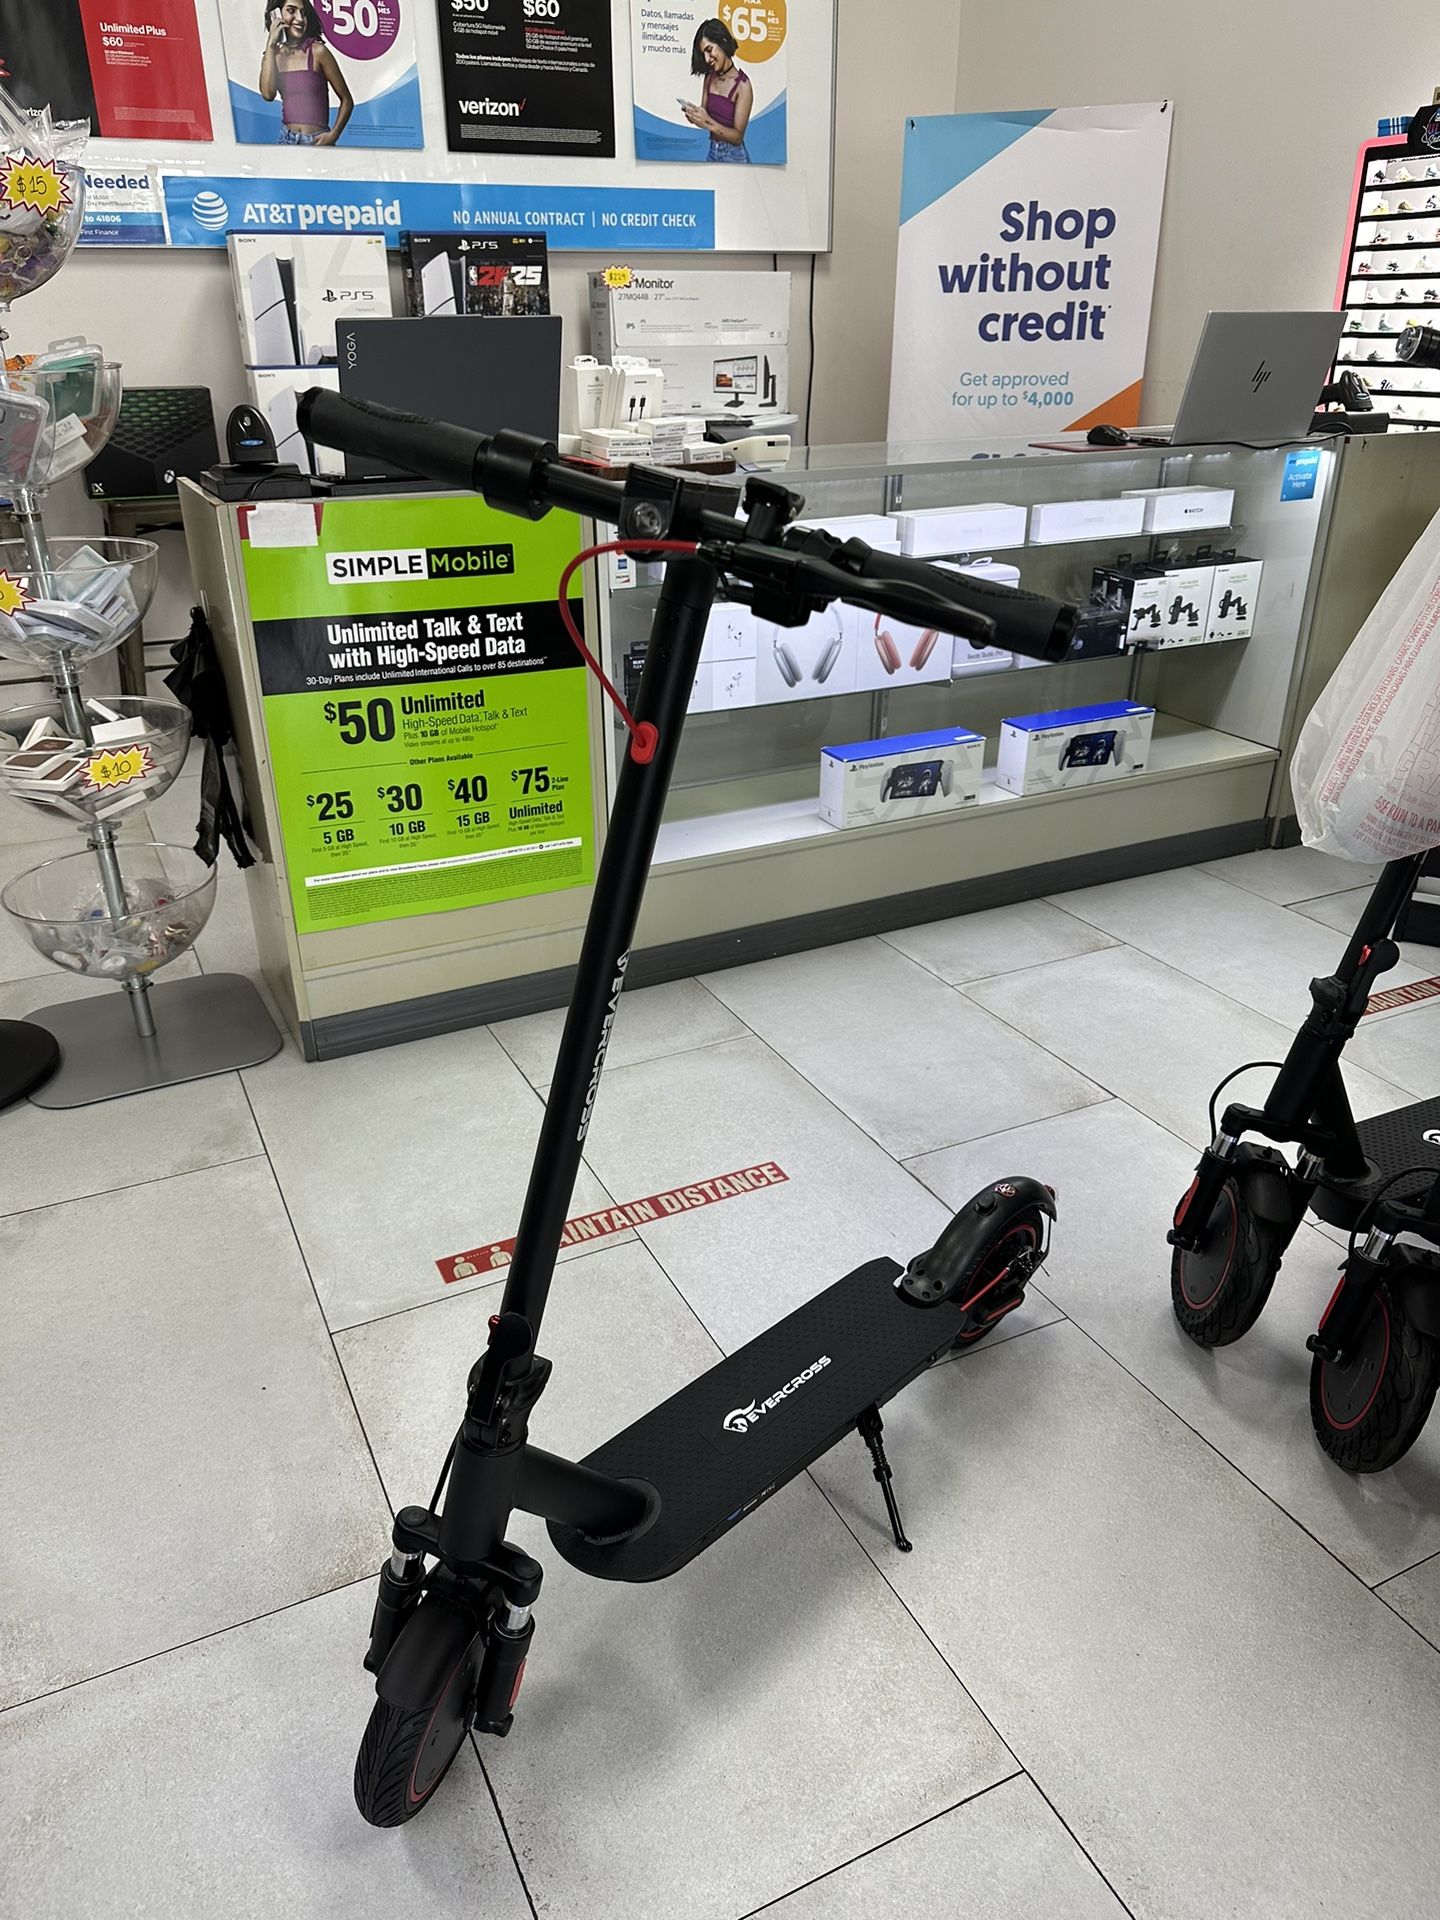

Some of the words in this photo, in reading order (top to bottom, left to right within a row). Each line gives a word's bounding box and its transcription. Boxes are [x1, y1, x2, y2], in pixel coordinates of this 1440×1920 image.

[322, 0, 379, 37] $50
[523, 0, 560, 18] $60
[641, 9, 663, 19] Datos,
[664, 10, 695, 21] llamadas
[100, 22, 145, 34] Unlimited
[145, 25, 167, 36] Plus
[647, 21, 679, 32] mensajes
[722, 4, 768, 43] $65
[768, 17, 780, 25] MES
[102, 36, 124, 47] $60
[648, 43, 672, 53] mucho
[672, 46, 687, 54] más
[459, 97, 520, 116] verizon
[85, 175, 150, 190] Needed
[85, 215, 95, 223] to
[96, 215, 122, 223] 41806
[243, 202, 295, 224] AT&T
[298, 198, 402, 230] prepaid
[453, 210, 470, 224] NO
[474, 210, 522, 225] ANNUAL
[524, 211, 585, 226] CONTRACT
[602, 212, 618, 226] NO
[620, 213, 659, 227] CREDIT
[662, 213, 697, 227] CHECK
[999, 200, 1117, 249] Shop
[471, 240, 499, 250] PS5
[938, 252, 1112, 294] without
[635, 278, 674, 289] Monitor
[340, 290, 374, 301] PS5
[347, 331, 358, 370] YOGA
[960, 372, 988, 387] Get
[992, 371, 1070, 390] approved
[952, 391, 973, 407] for
[977, 395, 998, 411] up
[1001, 392, 1018, 407] to
[1022, 390, 1074, 409] $4,000
[332, 555, 423, 578] SIMPLE
[431, 551, 509, 574] Mobile
[327, 619, 419, 645] Unlimited
[423, 616, 462, 639] Talk
[467, 614, 482, 636] &
[486, 612, 524, 633] Text
[329, 648, 372, 670] with
[376, 642, 479, 670] High-Speed
[485, 636, 526, 657] Data
[967, 652, 981, 660] Beats
[981, 651, 996, 659] Studio
[306, 674, 333, 687] 30-Day
[333, 673, 355, 684] Plans
[355, 671, 381, 682] include
[381, 669, 415, 680] Unlimited
[415, 666, 456, 678] International
[456, 664, 474, 674] Calls
[474, 663, 481, 672] to
[482, 663, 497, 671] over
[497, 660, 507, 669] 85
[401, 689, 485, 715] Unlimited
[323, 697, 396, 745] $50
[402, 714, 458, 732] High-Speed
[483, 710, 500, 721] Talk
[501, 709, 509, 719] &
[510, 707, 528, 718] Text
[403, 731, 420, 740] Plus
[420, 730, 428, 738] 10
[428, 729, 440, 737] GB
[441, 728, 448, 736] of
[449, 726, 471, 736] Mobile
[409, 757, 427, 766] Other
[427, 755, 445, 764] Plans
[446, 752, 474, 762] Available
[858, 761, 885, 770] PlayStation
[100, 759, 132, 780] $10
[447, 774, 488, 804] $40
[511, 766, 550, 795] $75
[306, 790, 354, 822] $25
[376, 783, 423, 813] $30
[456, 814, 471, 828] 15
[474, 811, 490, 825] GB
[509, 799, 563, 820] Unlimited
[388, 822, 404, 836] 10
[408, 820, 426, 834] GB
[1406, 811, 1420, 828] TO
[1416, 814, 1427, 831] A
[323, 831, 333, 845] 5
[336, 828, 355, 843] GB
[558, 1201, 656, 1248] AINTAIN
[657, 1162, 785, 1215] DISTANCE
[748, 1355, 832, 1425] EVERCROSS
